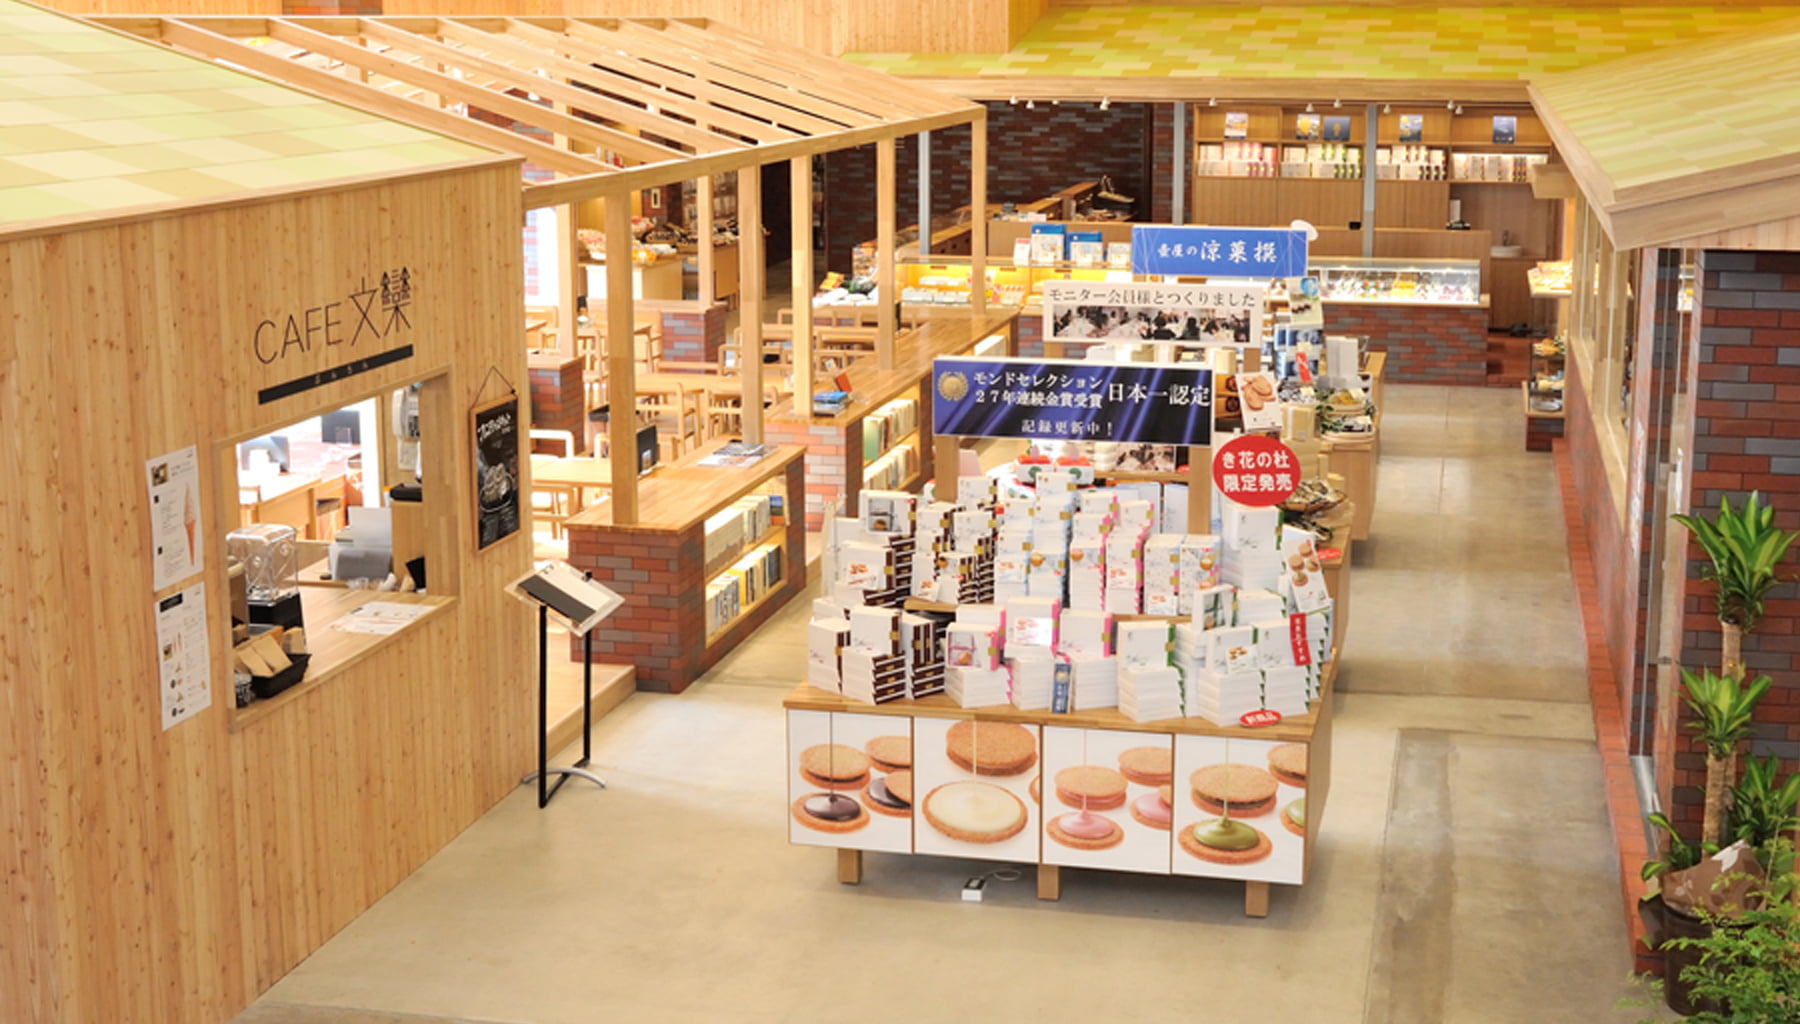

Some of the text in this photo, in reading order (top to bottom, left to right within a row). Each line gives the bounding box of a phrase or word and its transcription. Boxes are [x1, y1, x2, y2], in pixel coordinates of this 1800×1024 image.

[1049, 287, 1256, 307] モニター会員様とつくりました
[254, 302, 343, 365] CAFE
[973, 372, 1103, 390] モンドセレクション
[1108, 383, 1211, 407] 日本一認定
[1222, 450, 1291, 470] き花の杜
[1223, 472, 1293, 493] 限定発売
